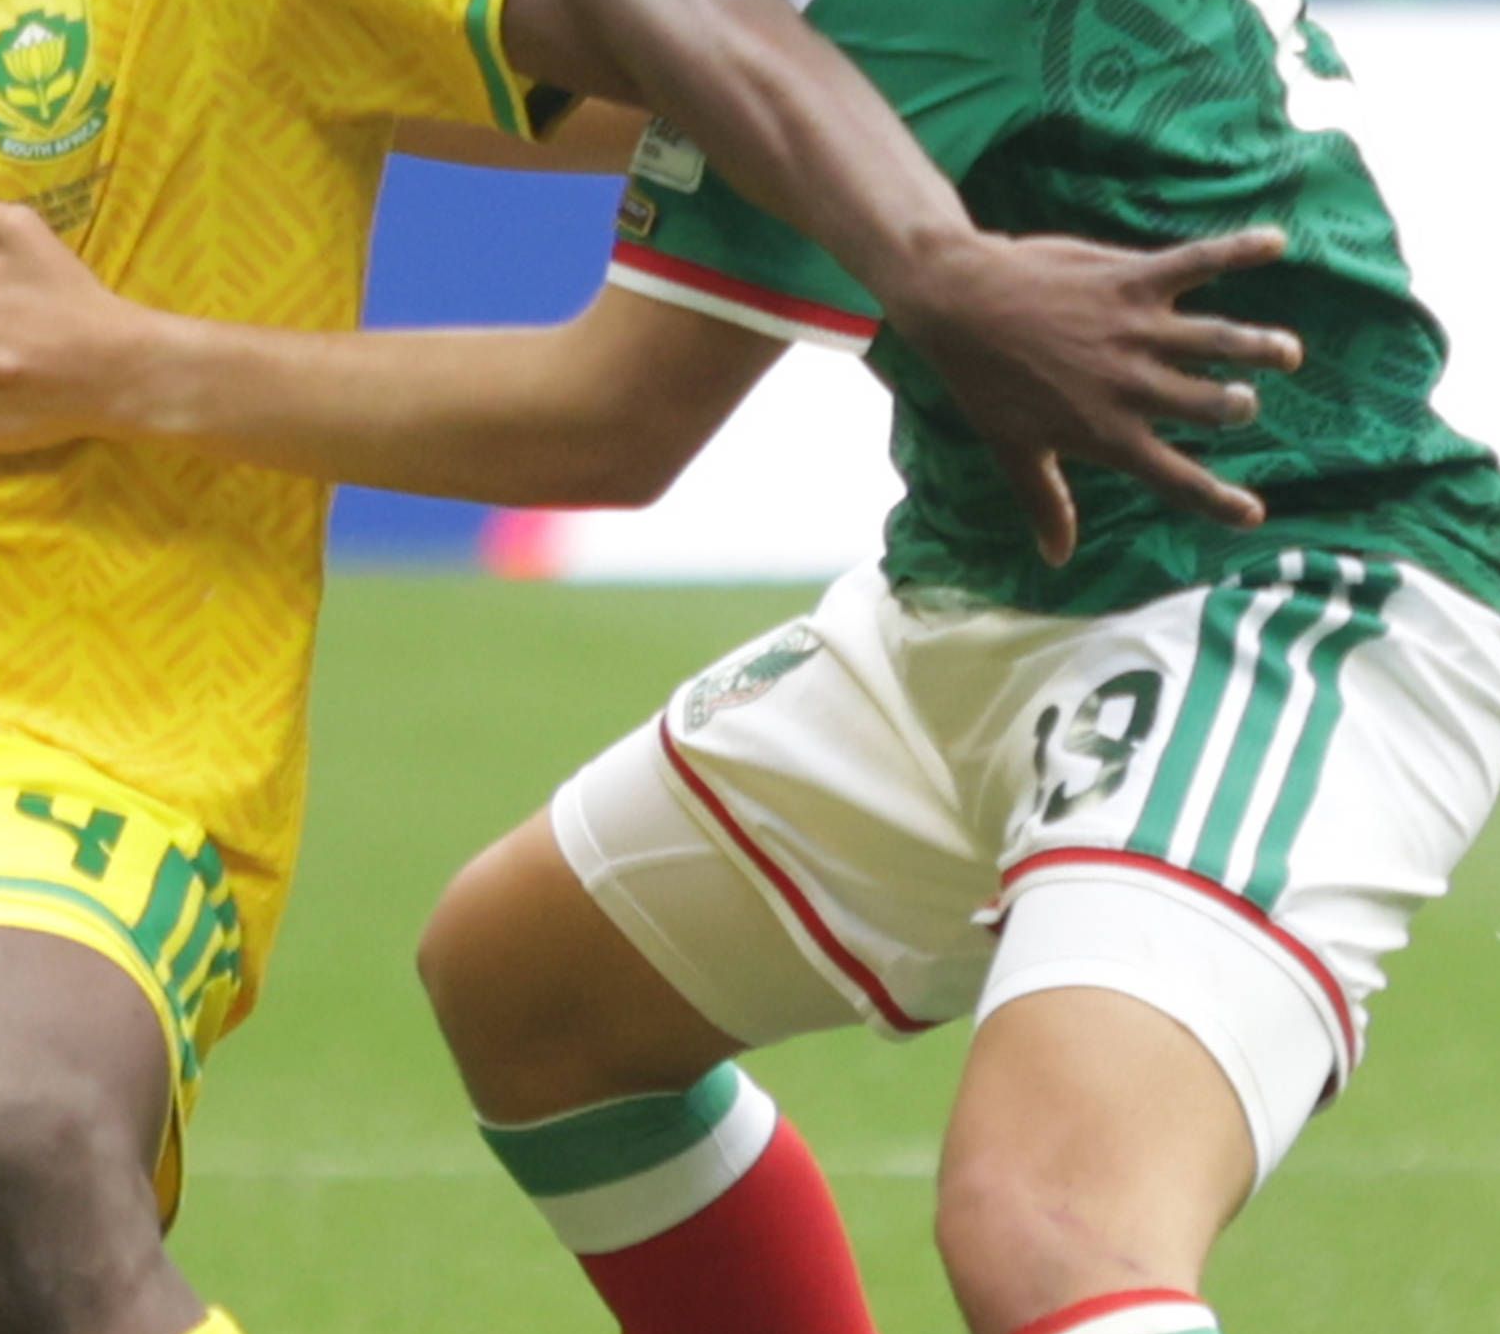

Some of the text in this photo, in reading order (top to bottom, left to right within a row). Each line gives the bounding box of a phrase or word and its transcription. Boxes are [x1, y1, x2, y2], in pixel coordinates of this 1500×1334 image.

[1, 117, 101, 158] SOUTH AFRICA
[1032, 668, 1163, 826] 19
[14, 790, 127, 881] 4
